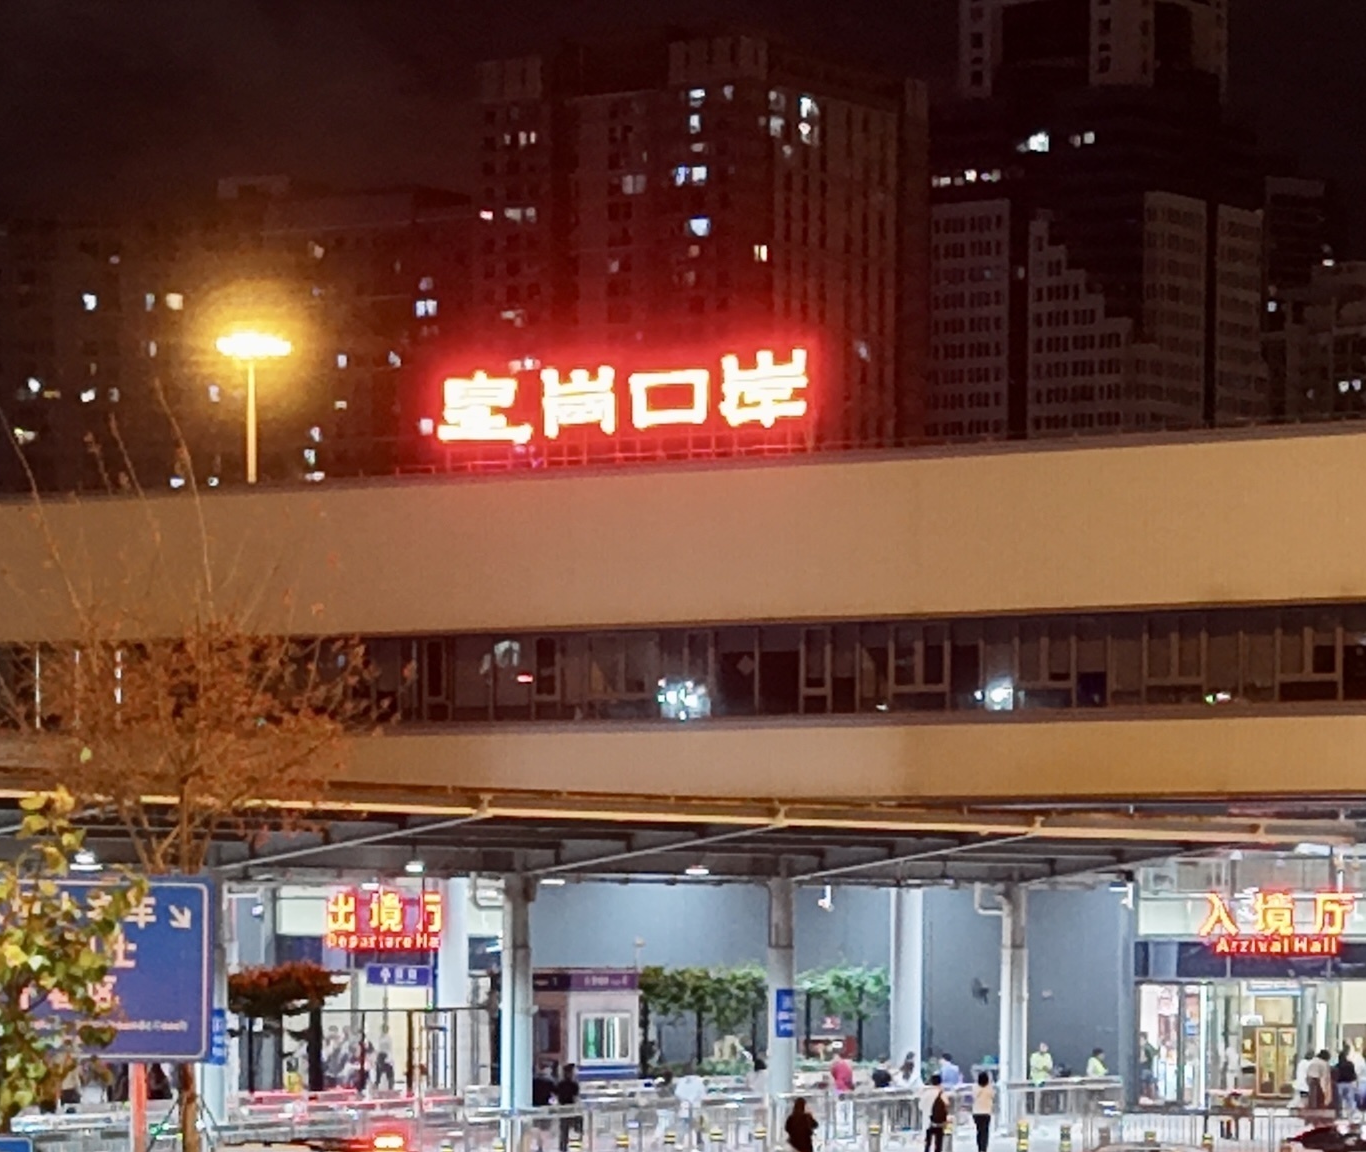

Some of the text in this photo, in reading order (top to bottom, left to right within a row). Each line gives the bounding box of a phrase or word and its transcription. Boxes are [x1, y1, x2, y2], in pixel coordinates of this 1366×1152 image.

[437, 347, 809, 445] 皇岗口岸
[327, 889, 442, 933] 出境厅
[1199, 891, 1356, 937] 入境厅
[1293, 936, 1338, 954] Hall
